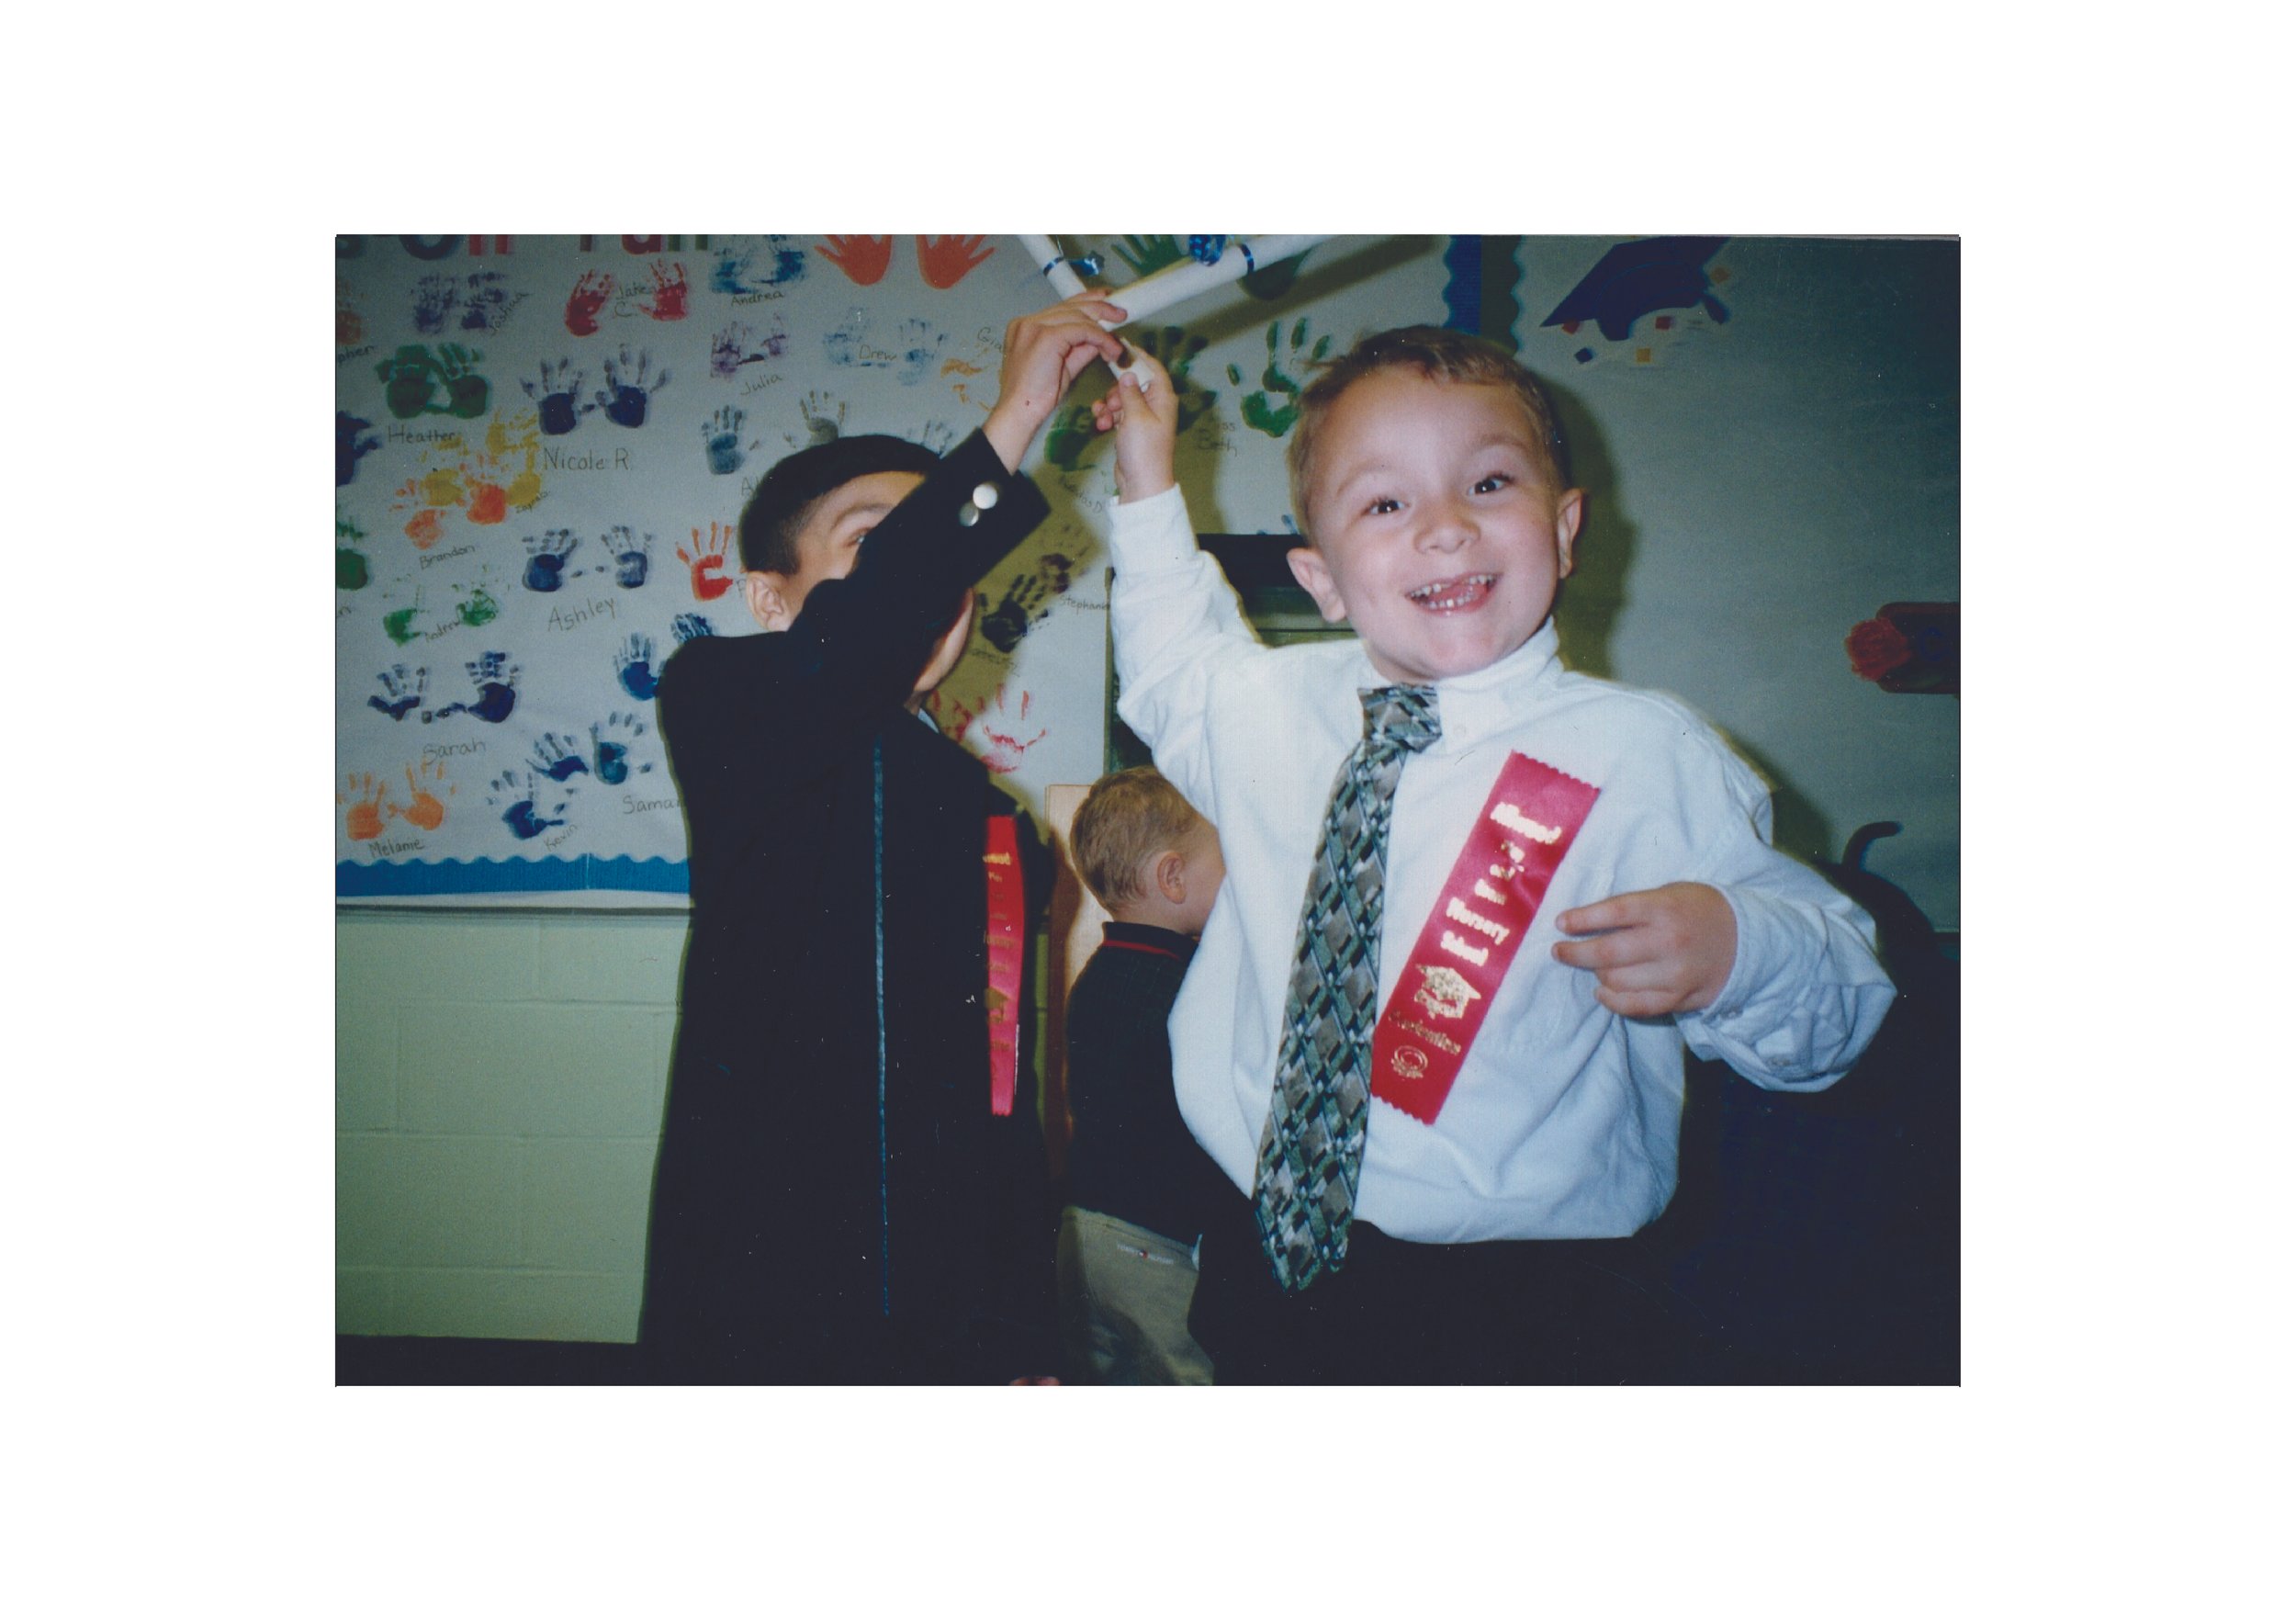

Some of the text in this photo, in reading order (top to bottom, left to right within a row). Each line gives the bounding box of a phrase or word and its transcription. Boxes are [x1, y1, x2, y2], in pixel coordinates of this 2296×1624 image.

[730, 288, 784, 307] Andrea
[858, 343, 897, 362] Drew
[740, 372, 782, 397] Julia
[387, 423, 457, 445] Heather
[543, 447, 606, 471] Nicole
[418, 543, 477, 570] Brandon
[546, 596, 617, 632] Ashley
[422, 738, 488, 766] Sarah
